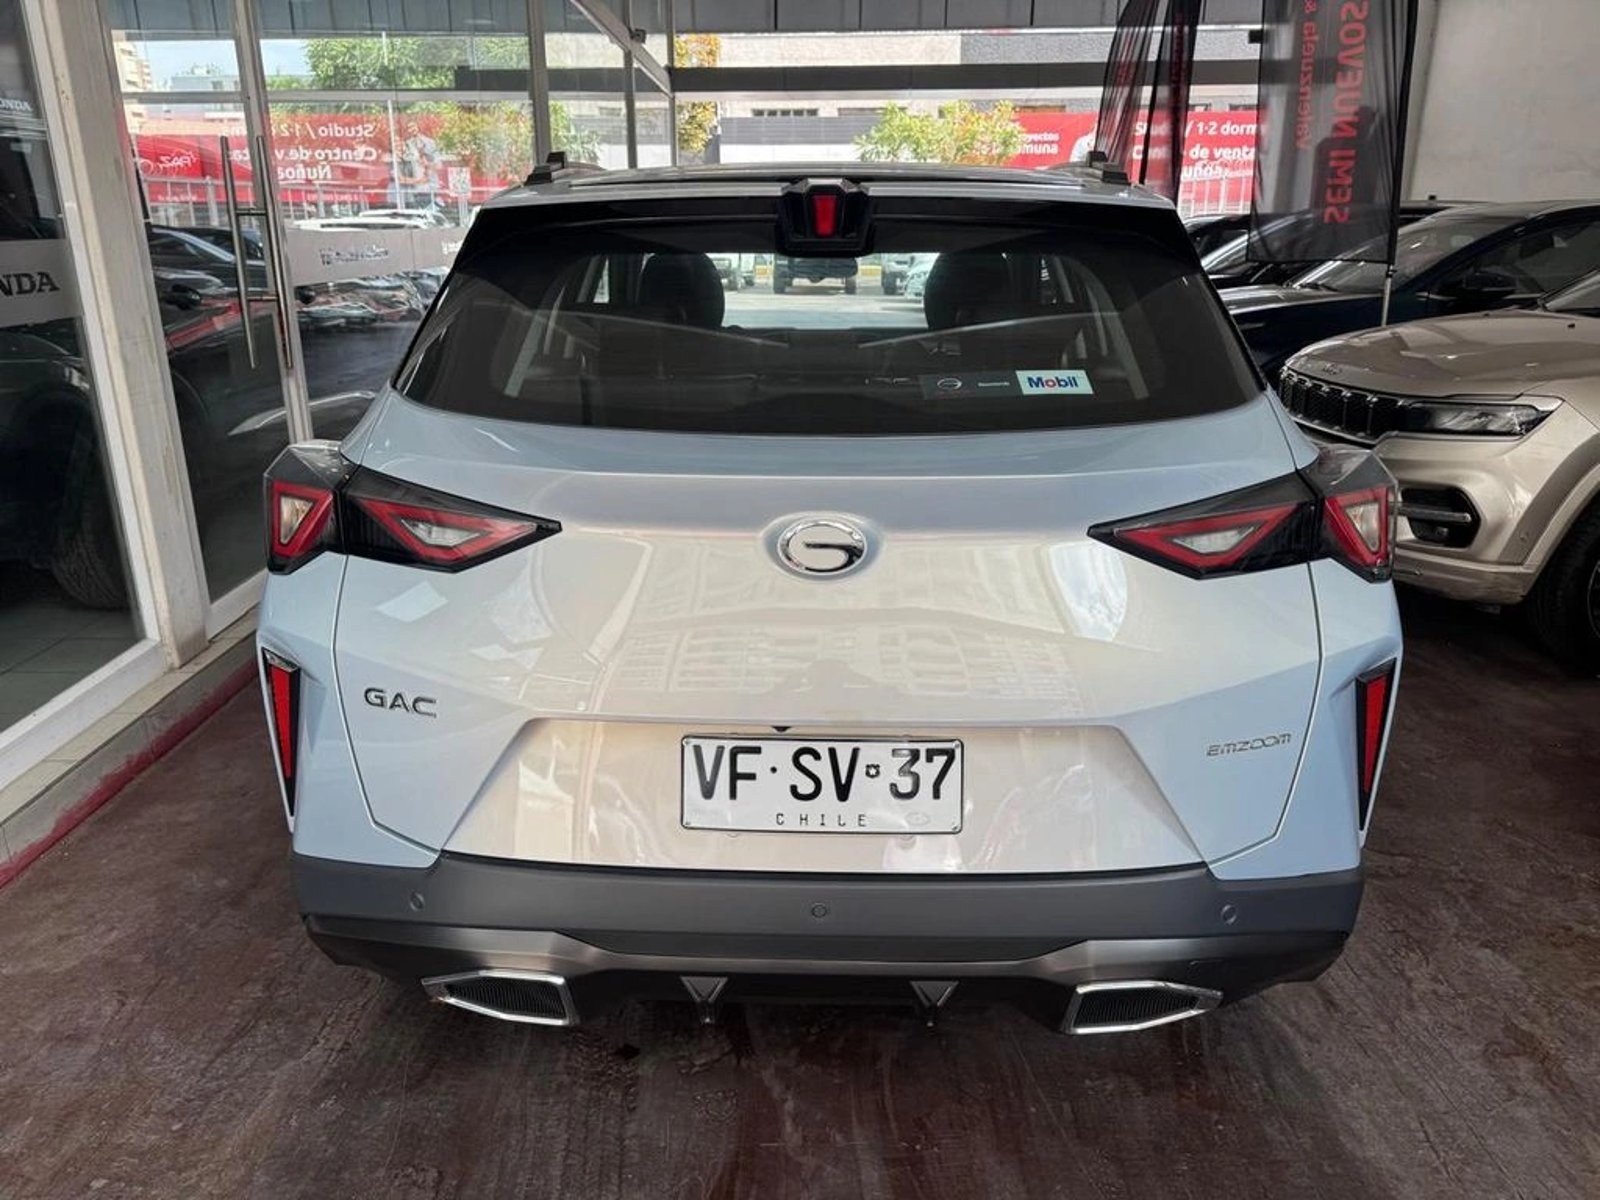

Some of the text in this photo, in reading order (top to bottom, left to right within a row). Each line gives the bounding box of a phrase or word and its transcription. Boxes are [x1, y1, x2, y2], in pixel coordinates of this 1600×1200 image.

[1189, 143, 1210, 160] de
[1027, 375, 1079, 390] Mobil
[363, 687, 438, 719] GAC
[775, 812, 868, 827] CHILE
